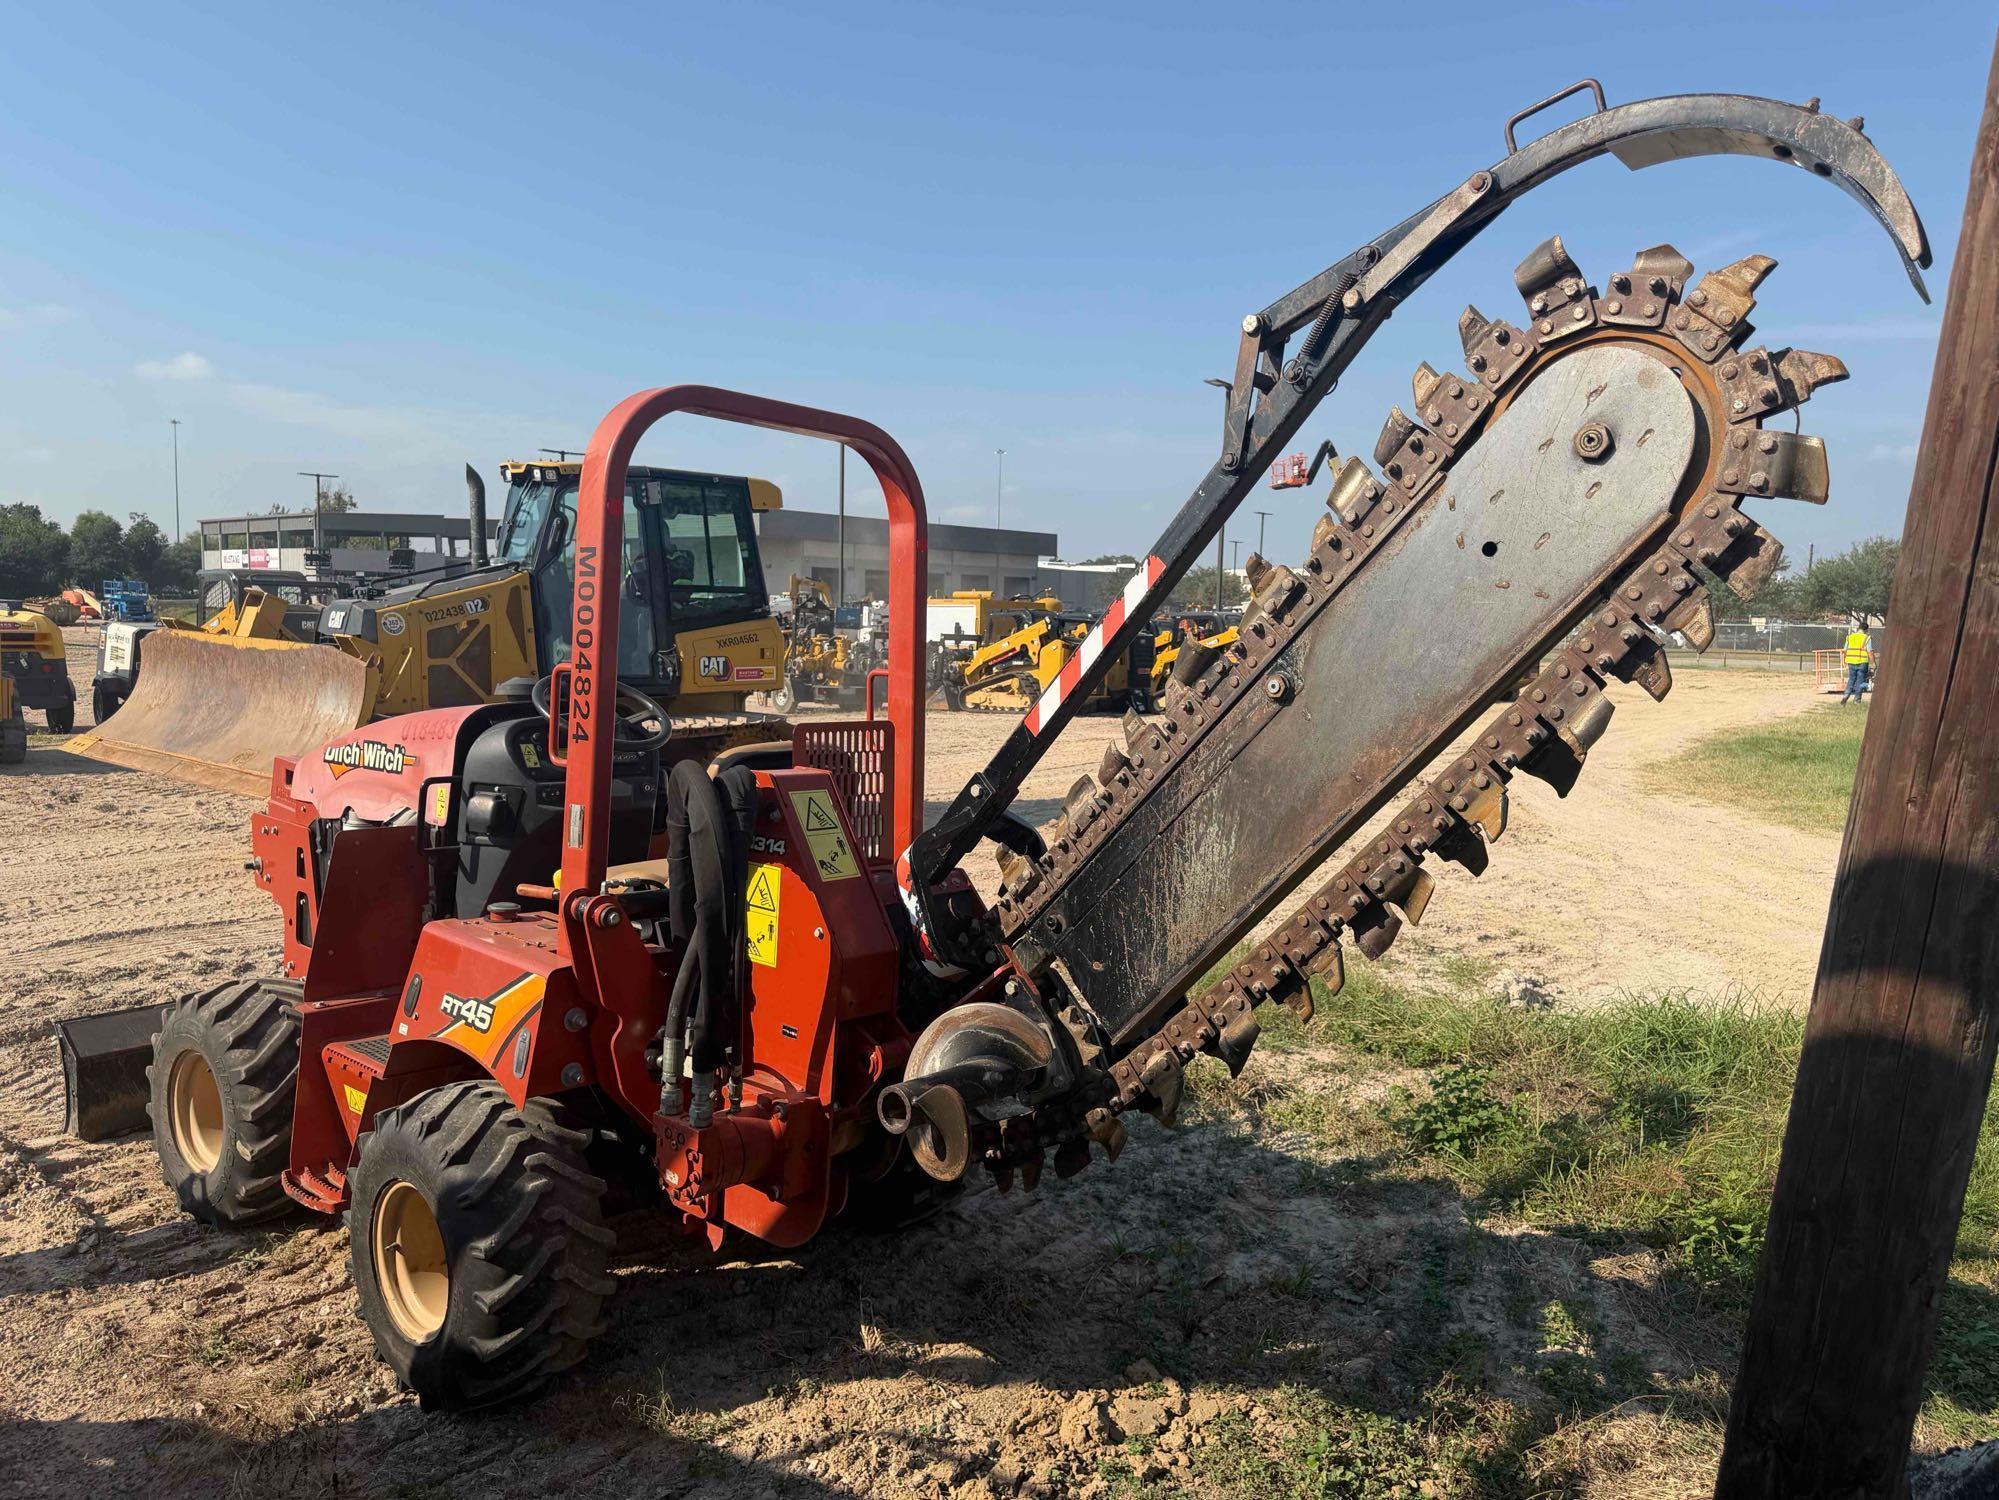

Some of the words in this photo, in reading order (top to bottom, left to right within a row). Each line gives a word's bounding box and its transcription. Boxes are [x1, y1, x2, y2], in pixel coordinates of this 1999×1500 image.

[465, 598, 485, 615] D2
[328, 611, 345, 628] CAT
[715, 633, 760, 649] XKR04562
[700, 656, 725, 676] CAT
[363, 741, 404, 772] Witch
[751, 836, 786, 855] 314
[440, 994, 494, 1030] RT45
